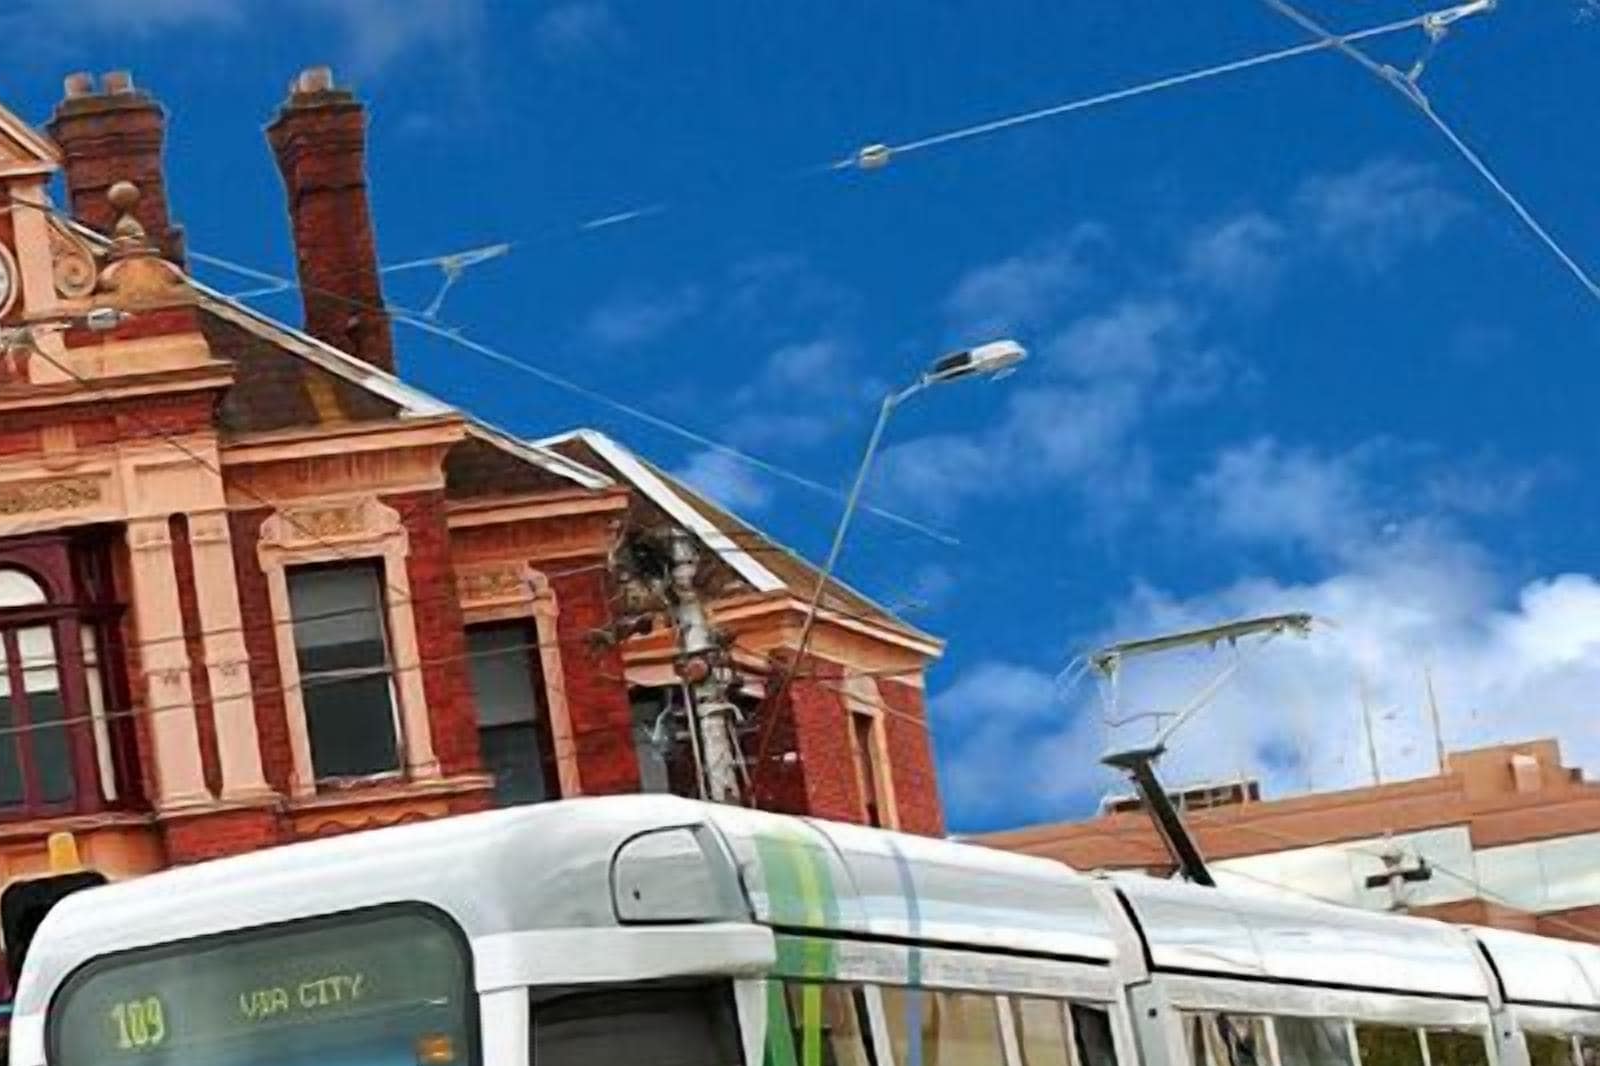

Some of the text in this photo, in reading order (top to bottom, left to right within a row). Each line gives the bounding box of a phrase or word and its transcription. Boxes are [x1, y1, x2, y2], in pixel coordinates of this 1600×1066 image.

[240, 973, 364, 1018] VIA CITY
[110, 995, 166, 1049] 109
